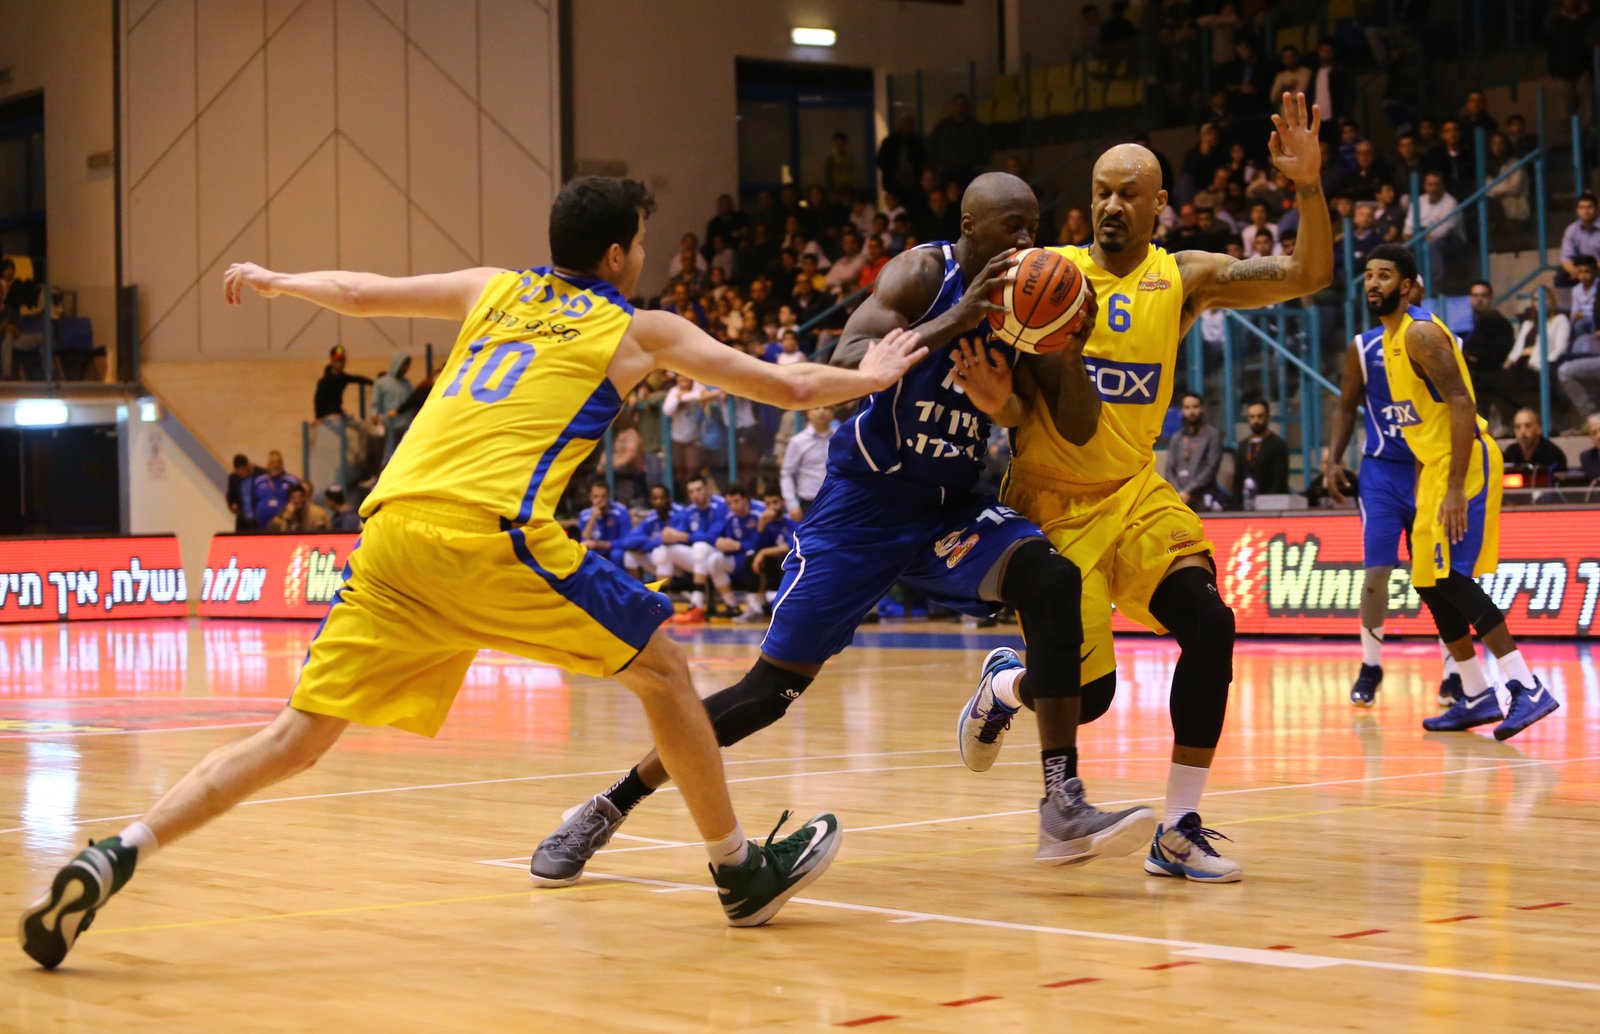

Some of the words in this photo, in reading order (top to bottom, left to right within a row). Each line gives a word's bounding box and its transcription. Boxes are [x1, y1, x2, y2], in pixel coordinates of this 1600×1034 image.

[1022, 250, 1050, 296] molte
[1108, 293, 1131, 332] 6
[442, 336, 536, 404] 10
[48, 571, 98, 615] איך
